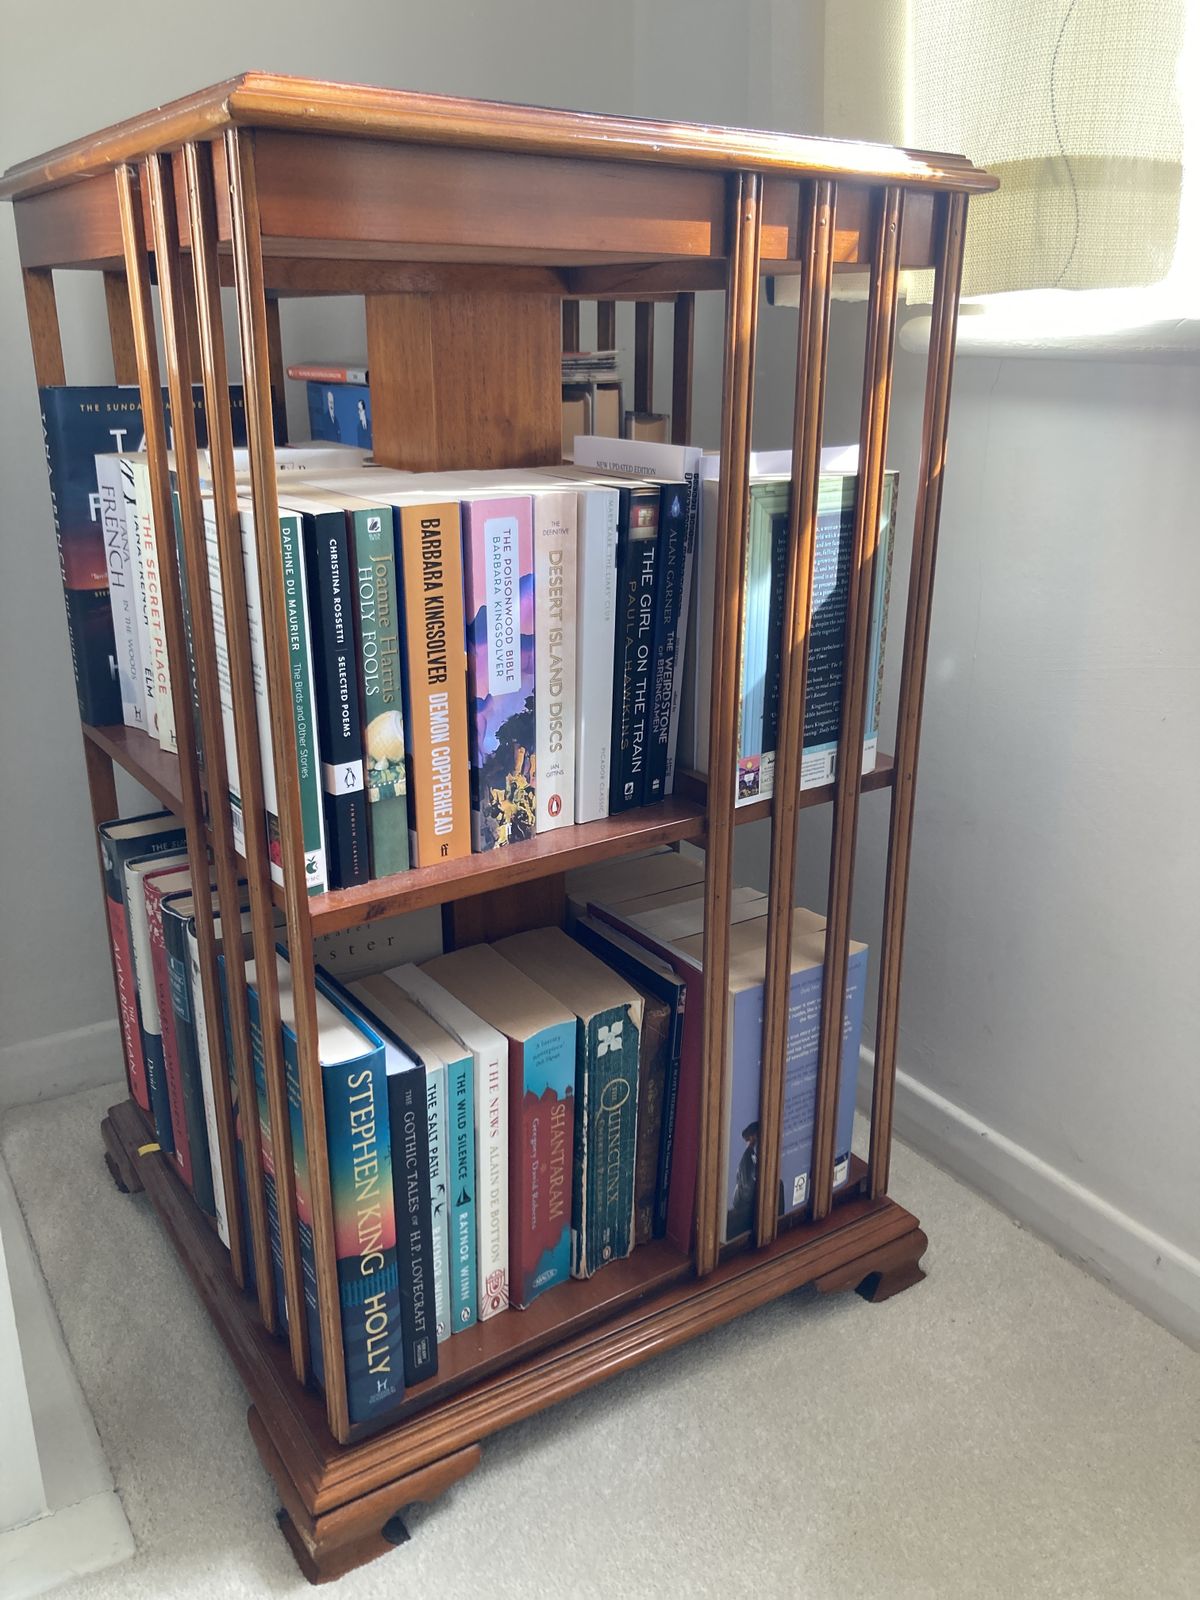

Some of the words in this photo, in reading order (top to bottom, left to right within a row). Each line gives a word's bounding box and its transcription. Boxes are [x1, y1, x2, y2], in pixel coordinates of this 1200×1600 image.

[80, 404, 100, 412] THE
[106, 402, 142, 412] SUNDA
[596, 460, 608, 469] NEW
[608, 462, 634, 473] UPDATED
[634, 465, 656, 475] EDITION
[102, 485, 125, 588] FRENCH
[142, 513, 154, 551] THE
[282, 527, 294, 576] DAPHNE
[420, 518, 444, 592] BARBARA
[503, 528, 512, 552] THE
[542, 528, 570, 536] DEFINITIVE
[668, 528, 678, 566] ALAN
[286, 580, 296, 596] DU
[329, 538, 342, 596] CHRISTINA
[492, 536, 502, 595] BARBARA
[548, 550, 563, 622] DESERT
[642, 547, 654, 586] THE
[146, 558, 161, 630] SECRET
[358, 567, 376, 628] HOLY
[369, 553, 393, 628] Joanne
[503, 558, 514, 645] POISONWOOD
[664, 570, 675, 624] GARNER
[288, 600, 300, 652] MAURIER
[333, 597, 345, 645] ROSSETTI
[626, 580, 637, 648] PAULA
[638, 594, 652, 638] GIRL
[424, 596, 448, 686] KINGSOLVER
[494, 601, 505, 678] KINGSOLVER
[549, 627, 563, 697] ISLAND
[637, 645, 648, 672] ON
[666, 631, 675, 652] THE
[144, 667, 154, 698] ELM
[153, 636, 168, 695] PLACE
[294, 662, 302, 680] The
[338, 656, 349, 702] SELECTED
[362, 631, 380, 696] FOOLS
[380, 634, 399, 704] Harris
[504, 650, 515, 682] BIBLE
[295, 681, 304, 704] Birds
[296, 705, 304, 722] and
[620, 661, 633, 750] HAWKINS
[634, 678, 647, 714] THE
[653, 658, 664, 733] BRISINGAMEN
[658, 656, 674, 744] WEIRDSTONE
[298, 723, 308, 748] Other
[342, 704, 351, 738] POEMS
[428, 692, 450, 744] DEMON
[550, 702, 563, 753] DISCS
[300, 748, 308, 780] Stories
[632, 720, 645, 774] TRAIN
[430, 746, 454, 836] COPPERHEAD
[546, 768, 565, 778] GITTINS
[151, 842, 168, 852] THE
[113, 939, 125, 990] ALAN
[128, 1006, 136, 1024] THE
[148, 1058, 158, 1090] David
[428, 1084, 437, 1110] THE
[456, 1072, 466, 1095] THE
[488, 1058, 499, 1094] THE
[404, 1090, 412, 1105] THE
[457, 1099, 467, 1130] WILD
[490, 1097, 500, 1139] NEWS
[348, 1070, 380, 1202] STEPHEN
[404, 1111, 418, 1168] GOTHIC
[428, 1112, 438, 1142] SALT
[595, 1078, 630, 1205] QUINCUNX
[428, 1147, 440, 1180] PATH
[458, 1134, 468, 1180] SILENCE
[490, 1146, 500, 1186] ALAIN
[549, 1104, 566, 1222] SHANTARAM
[406, 1170, 420, 1214] TALES
[490, 1187, 500, 1208] DE
[357, 1204, 385, 1276] KING
[410, 1215, 418, 1226] OF
[459, 1212, 470, 1263] RAYNOR
[490, 1209, 500, 1263] BOTTON
[432, 1226, 443, 1277] RAYNOR
[411, 1258, 426, 1333] LOVECRAFT
[435, 1281, 444, 1316] WINN
[460, 1265, 470, 1301] WINN
[364, 1291, 391, 1374] HOLLY
